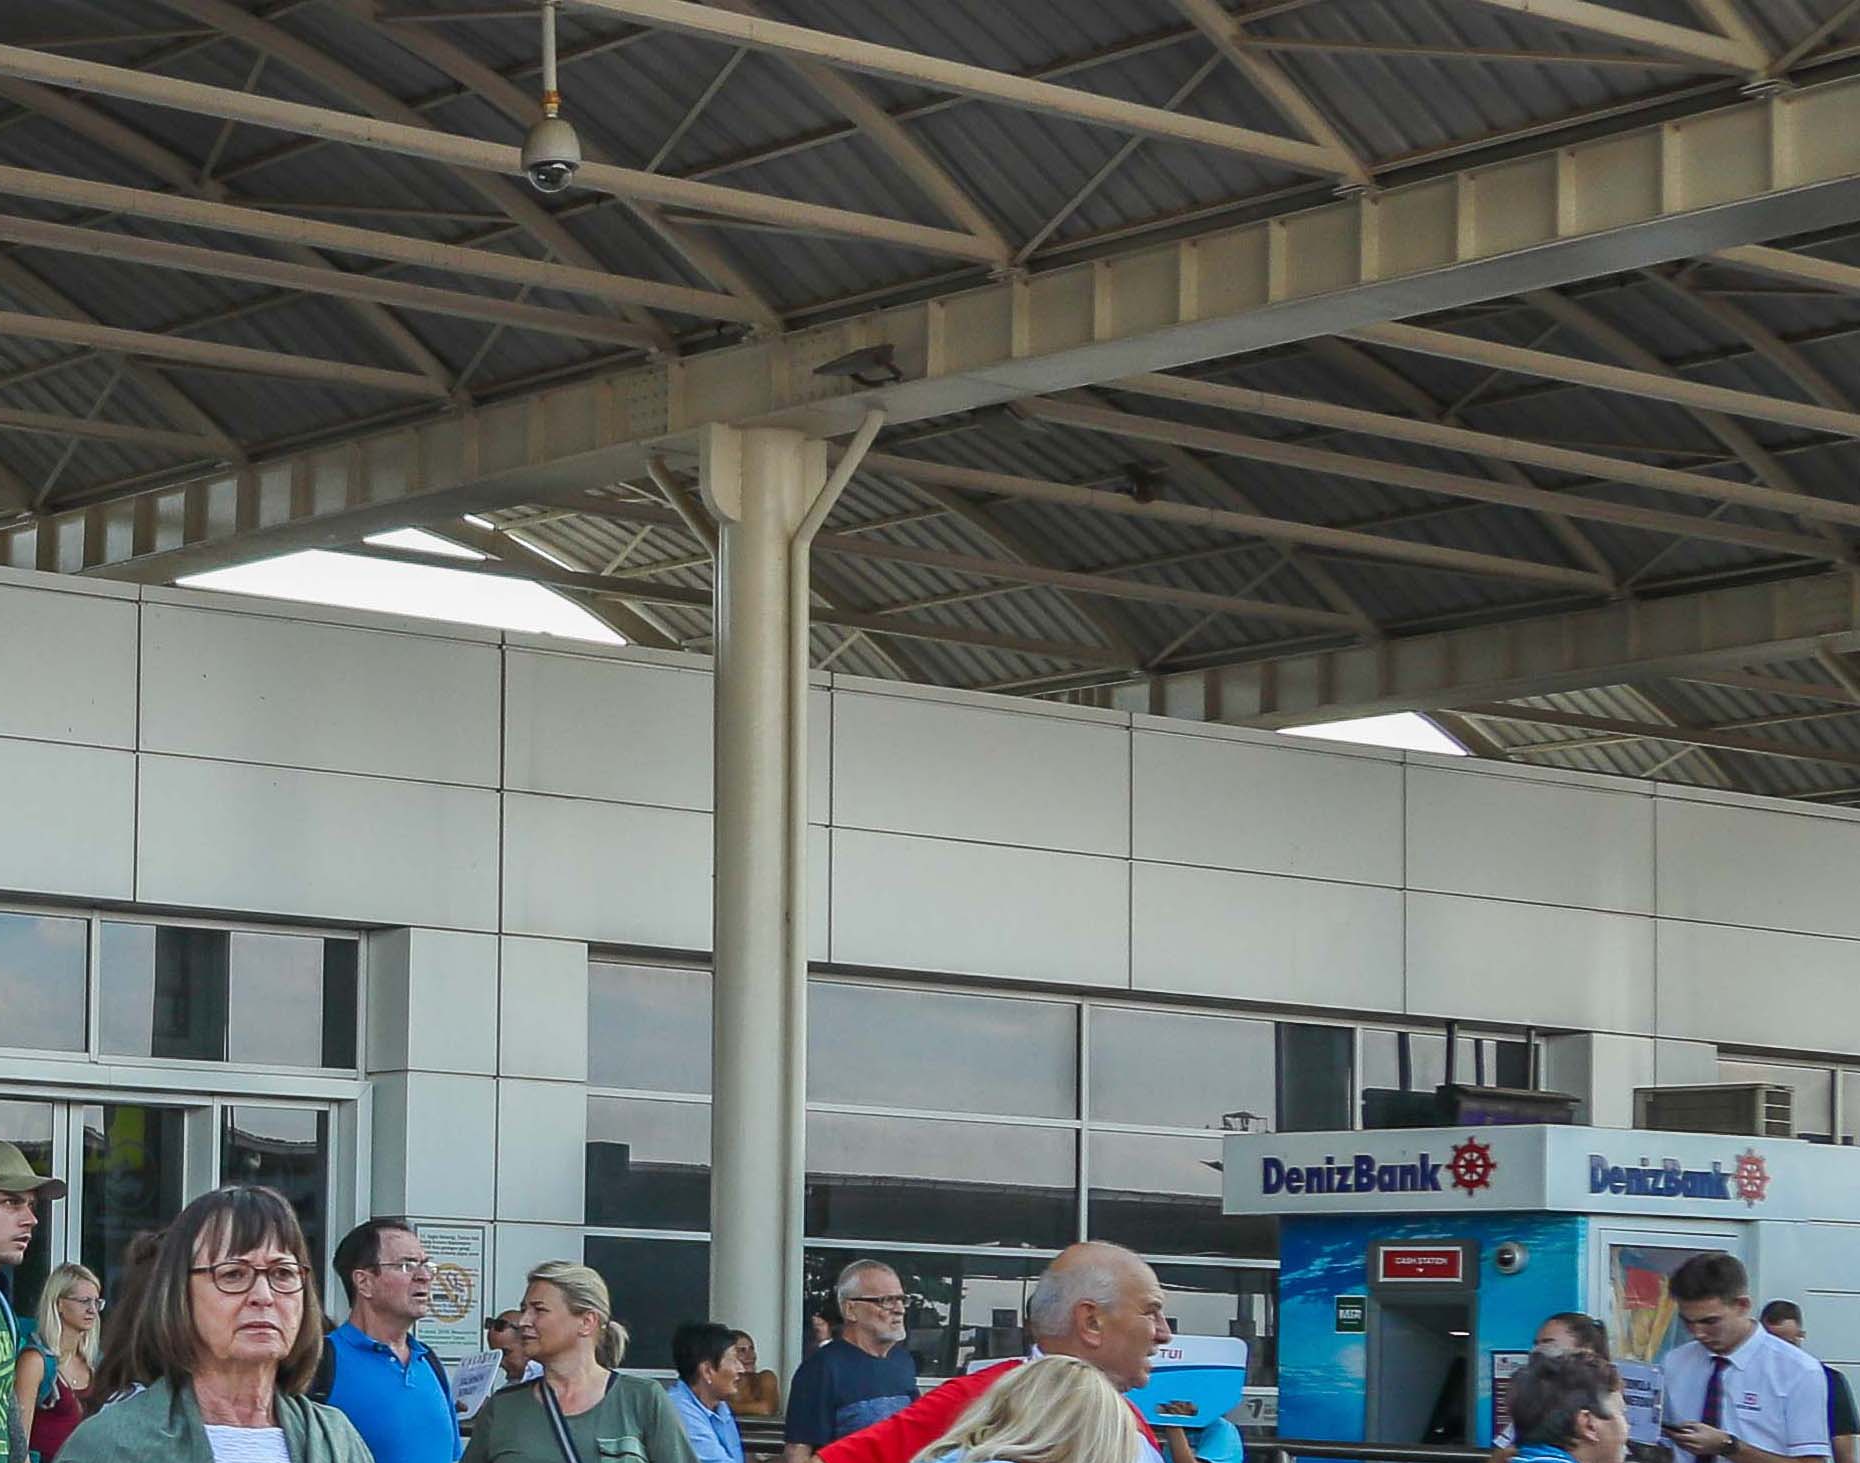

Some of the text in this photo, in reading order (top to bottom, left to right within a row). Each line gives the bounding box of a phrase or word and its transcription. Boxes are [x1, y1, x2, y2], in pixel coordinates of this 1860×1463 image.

[1262, 1153, 1442, 1195] DenizBank
[1589, 1154, 1731, 1199] DenizBank
[1159, 1348, 1182, 1360] TUI
